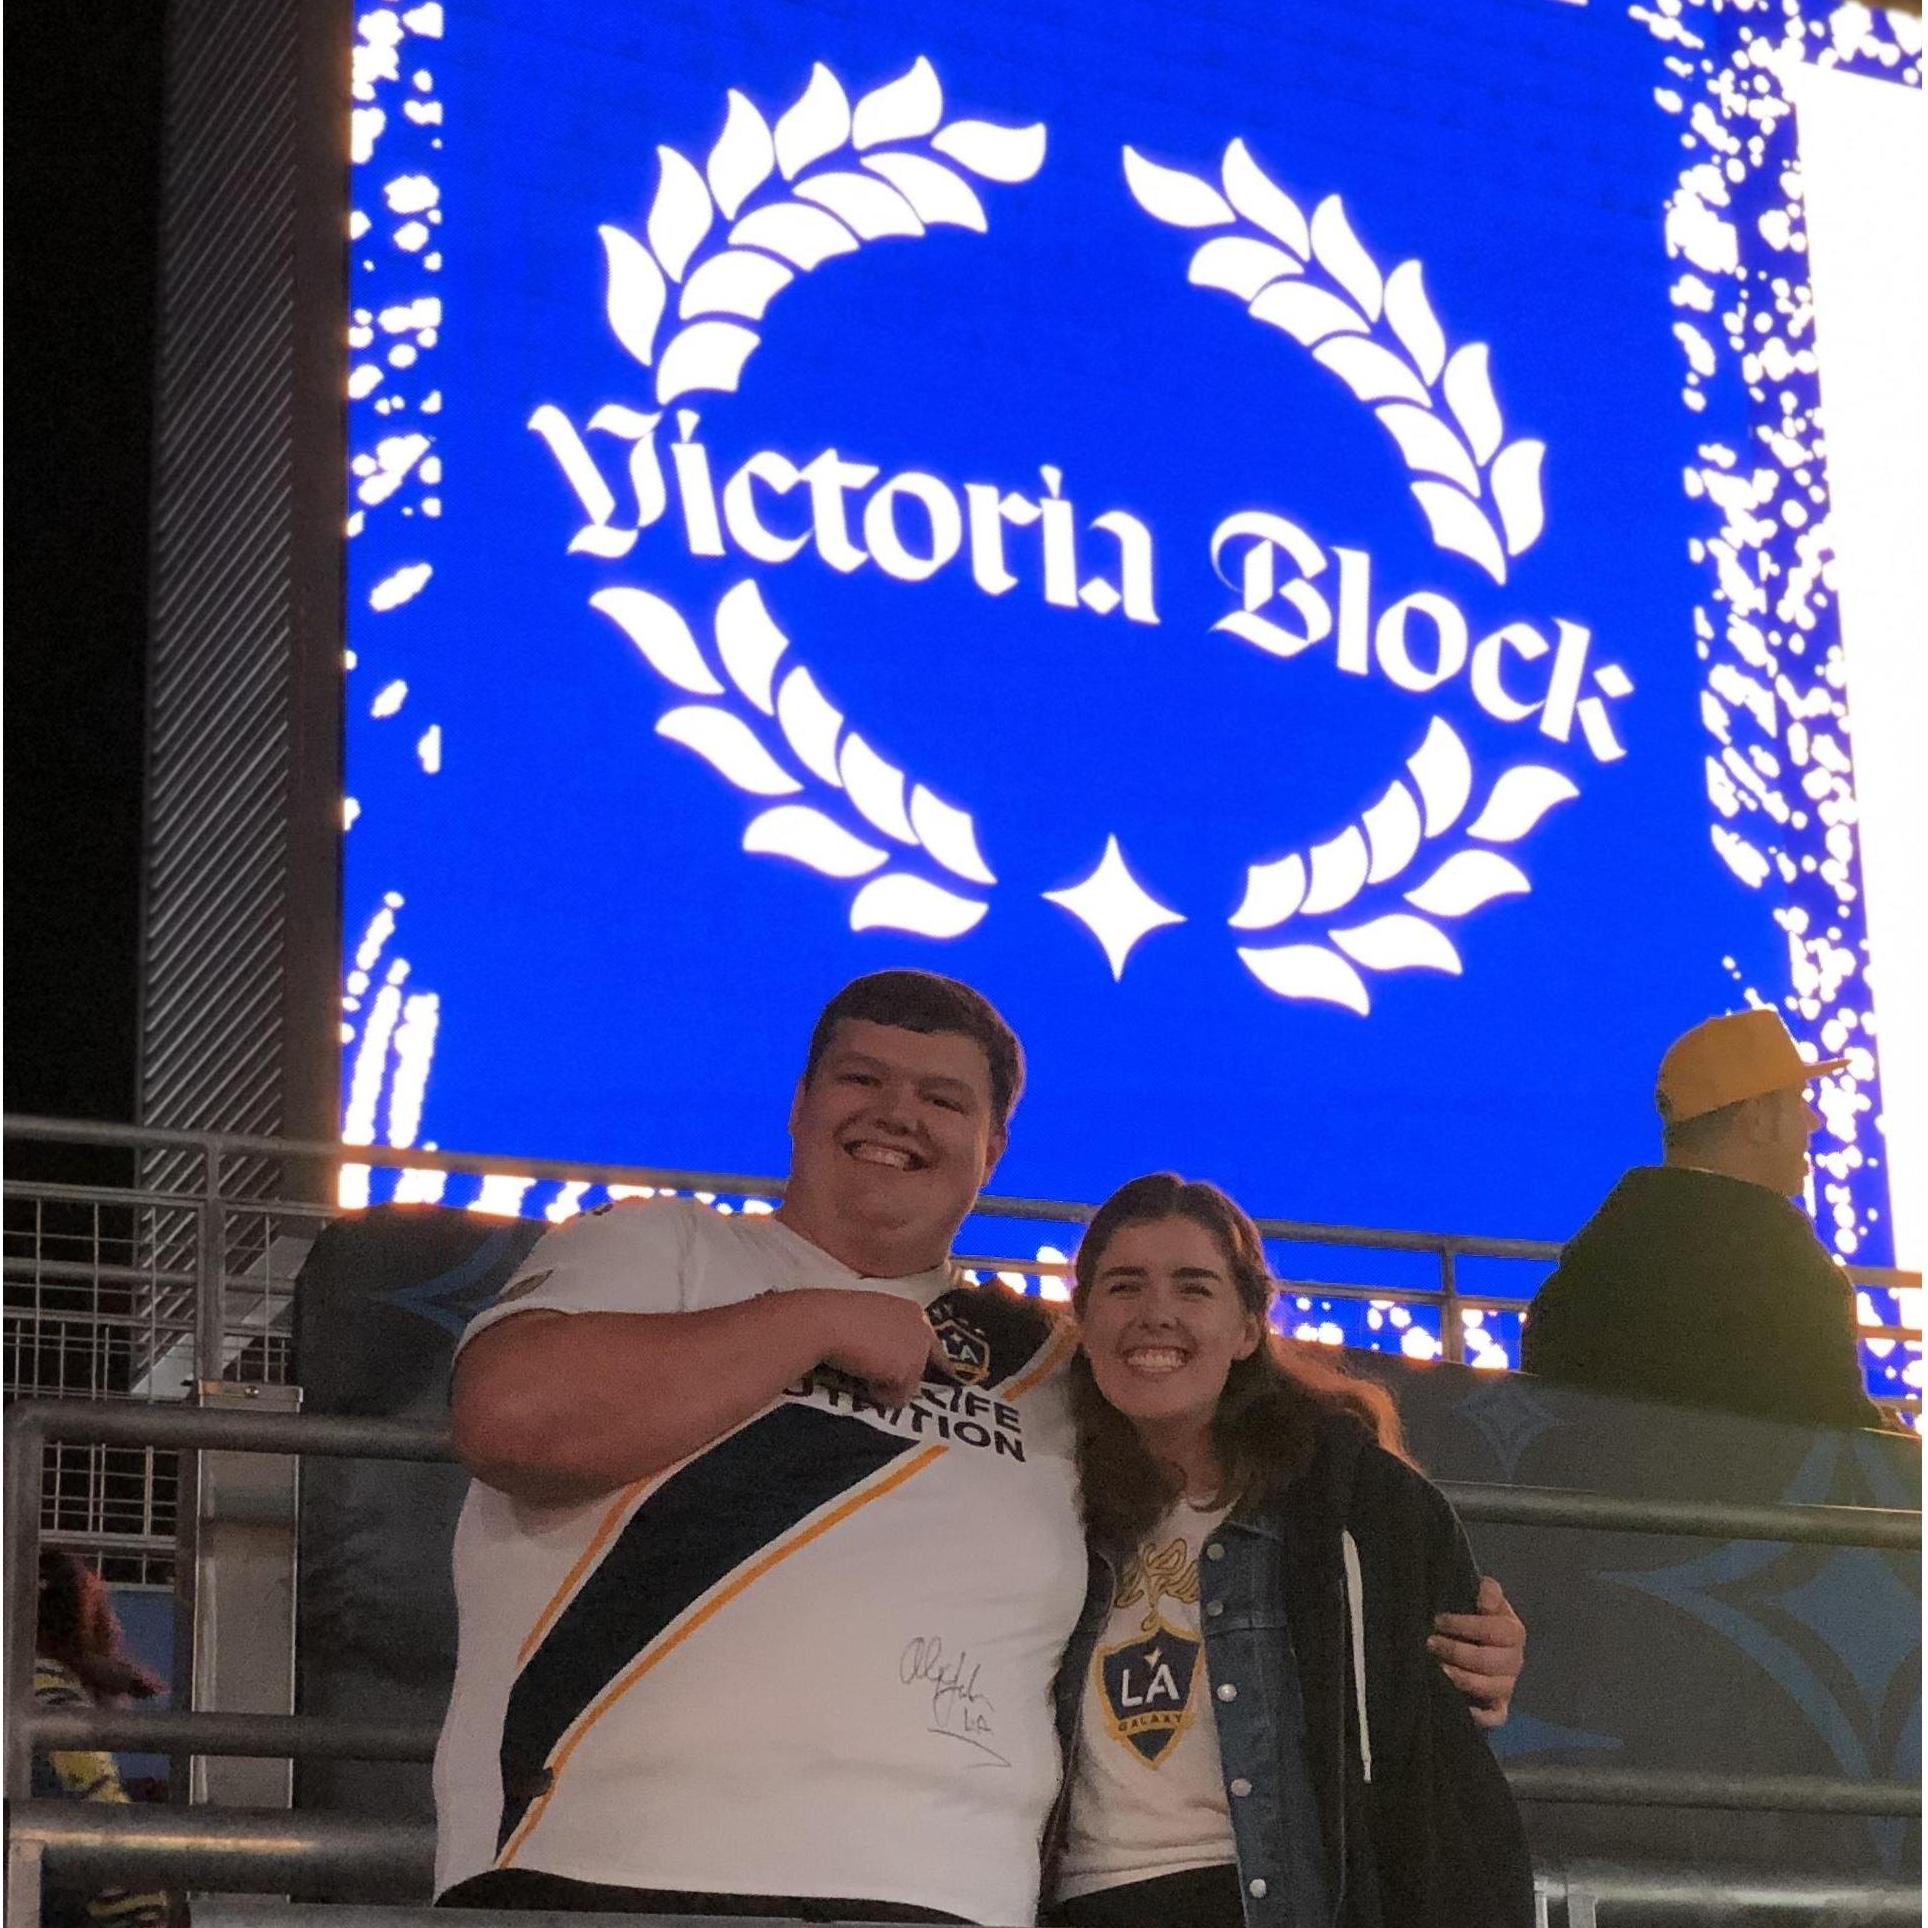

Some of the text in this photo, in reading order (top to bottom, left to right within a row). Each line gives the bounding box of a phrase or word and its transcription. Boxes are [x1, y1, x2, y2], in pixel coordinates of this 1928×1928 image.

[526, 403, 1636, 763] Victoria Block
[1121, 1663, 1180, 1708] LA
[1118, 1712, 1183, 1732] GALAXY
